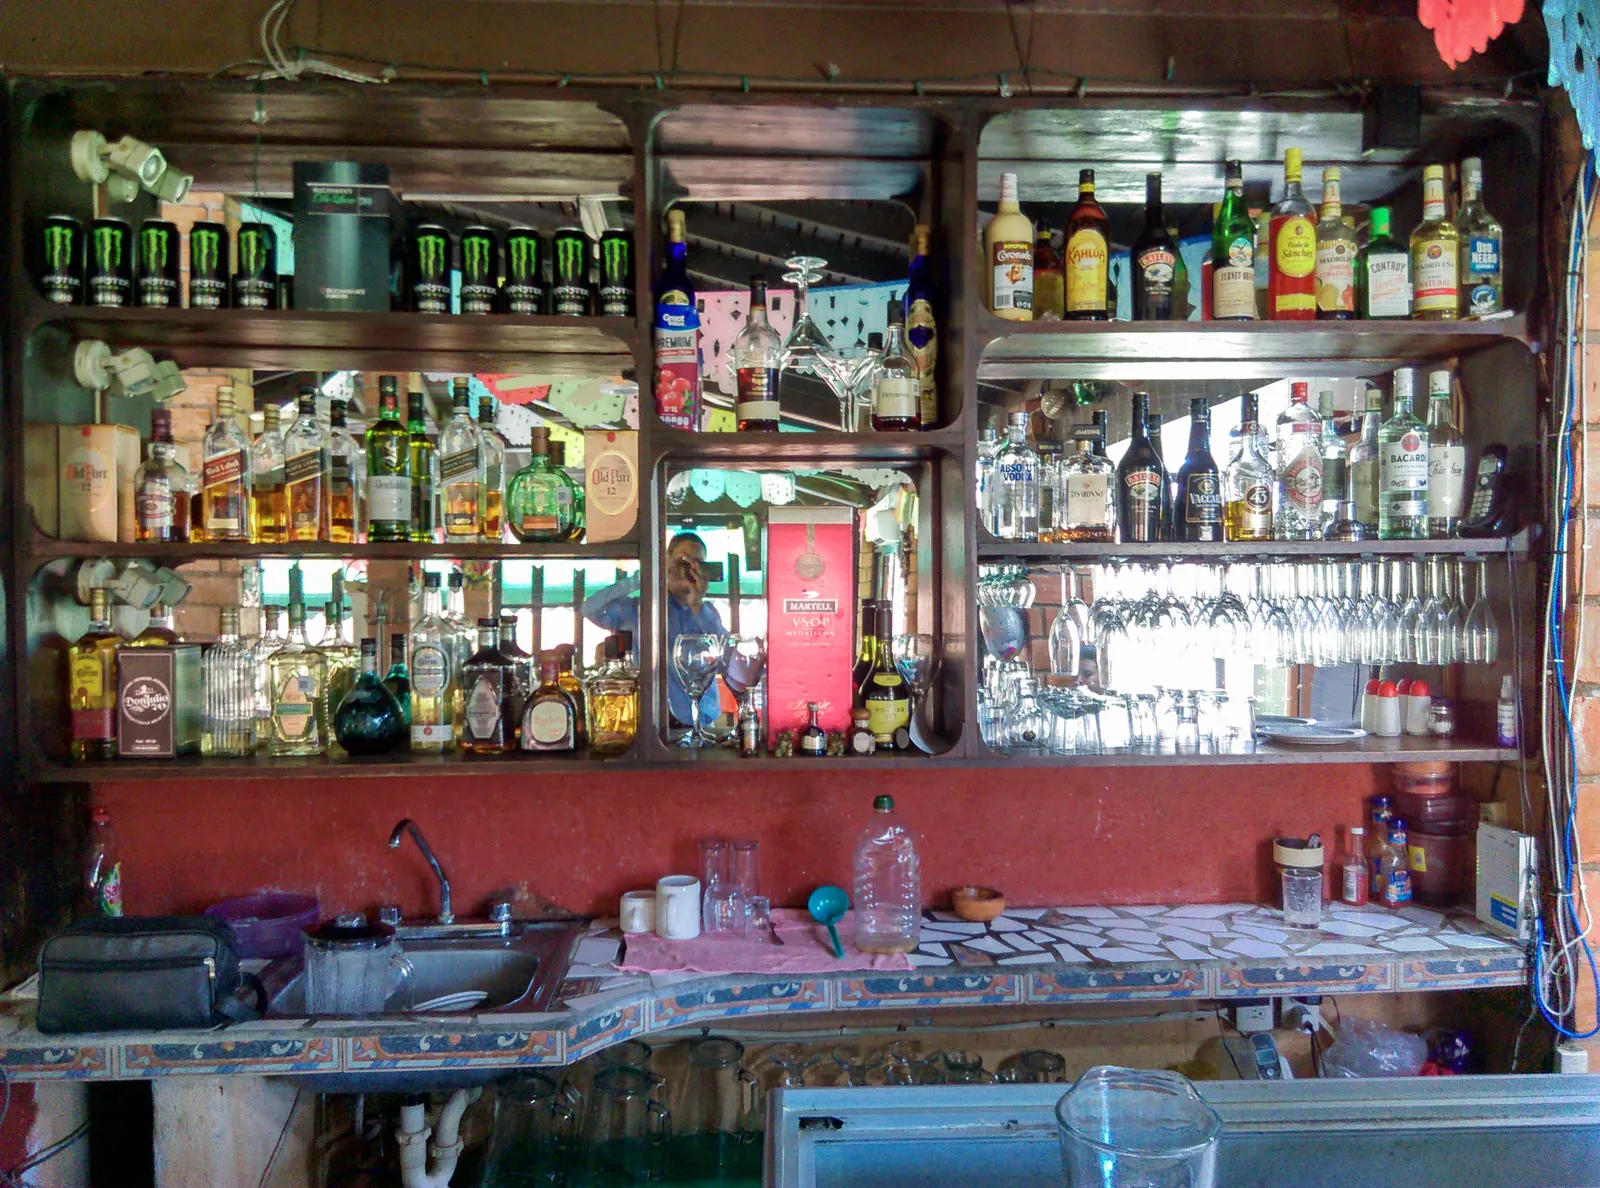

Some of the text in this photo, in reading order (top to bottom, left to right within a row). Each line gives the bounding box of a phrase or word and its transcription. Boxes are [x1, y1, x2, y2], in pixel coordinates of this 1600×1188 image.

[1476, 241, 1493, 253] OSO
[997, 250, 1032, 262] Coronado
[1471, 251, 1498, 264] NEGRO
[1371, 261, 1407, 274] CONTROY
[656, 336, 693, 348] PREMIUM
[1391, 453, 1427, 463] BACARDI
[1000, 463, 1035, 473] ABSOU
[592, 468, 631, 485] Old Parr
[607, 487, 616, 495] 12
[1250, 490, 1267, 503] 43
[790, 602, 832, 611] MARTELL
